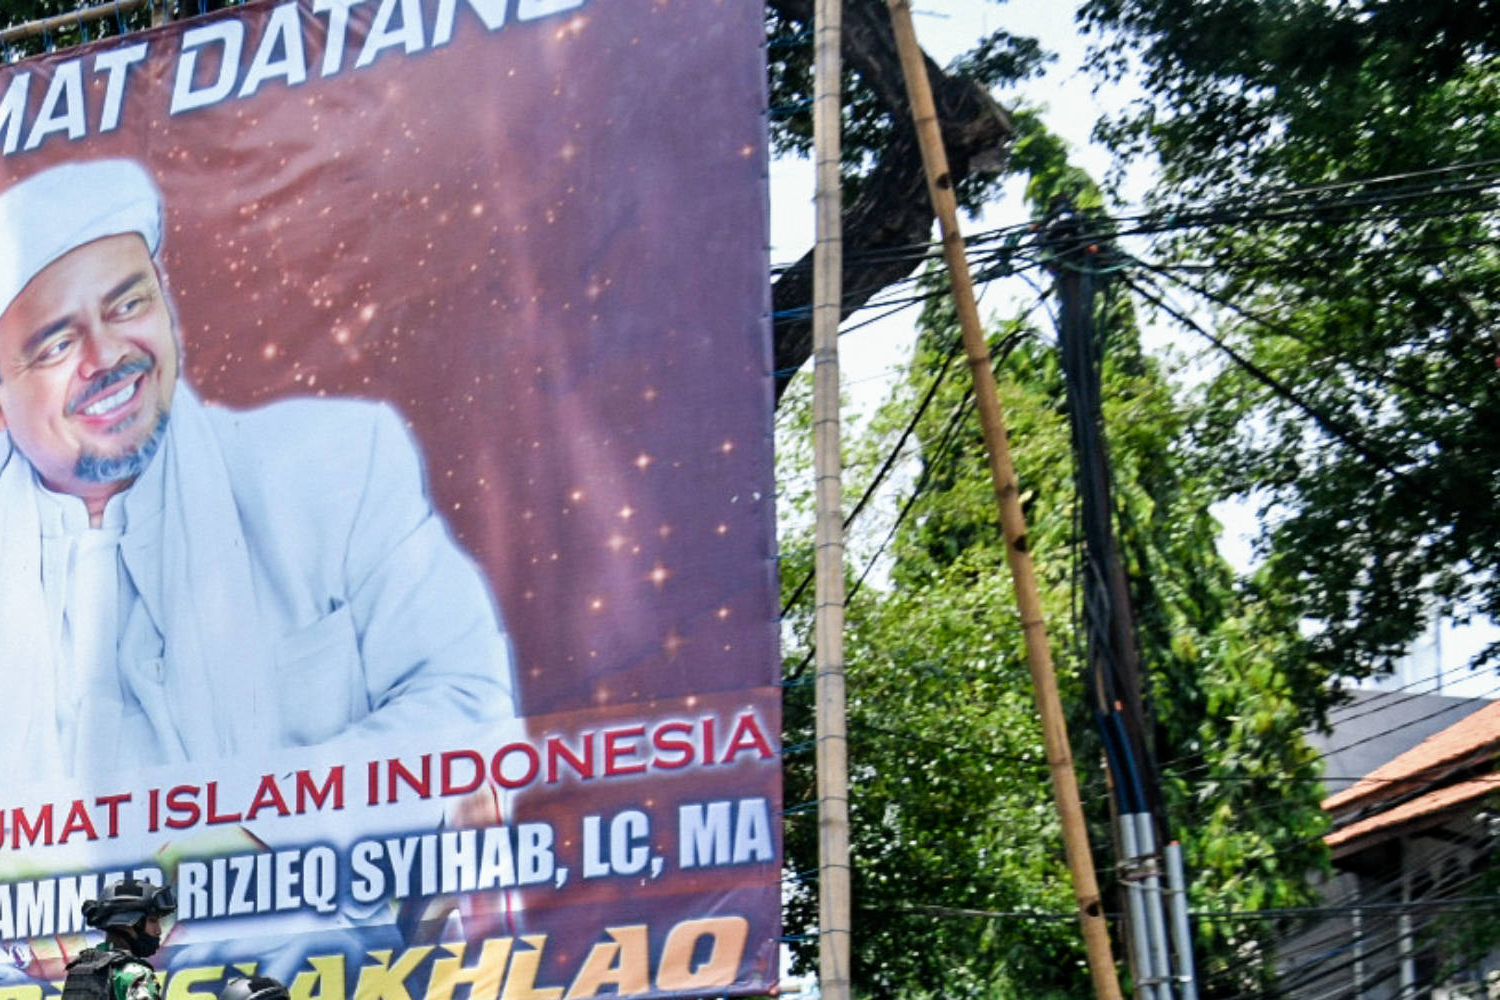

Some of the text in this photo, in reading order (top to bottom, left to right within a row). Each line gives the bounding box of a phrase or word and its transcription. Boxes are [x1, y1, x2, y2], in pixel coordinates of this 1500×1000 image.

[169, 0, 586, 116] DATA
[147, 764, 346, 833] ISLAM
[367, 713, 774, 807] INDONESIA
[177, 846, 338, 922] RIZIEQ
[350, 823, 568, 902] SYIHAB,
[582, 809, 665, 880] LC,
[678, 798, 775, 869] MA
